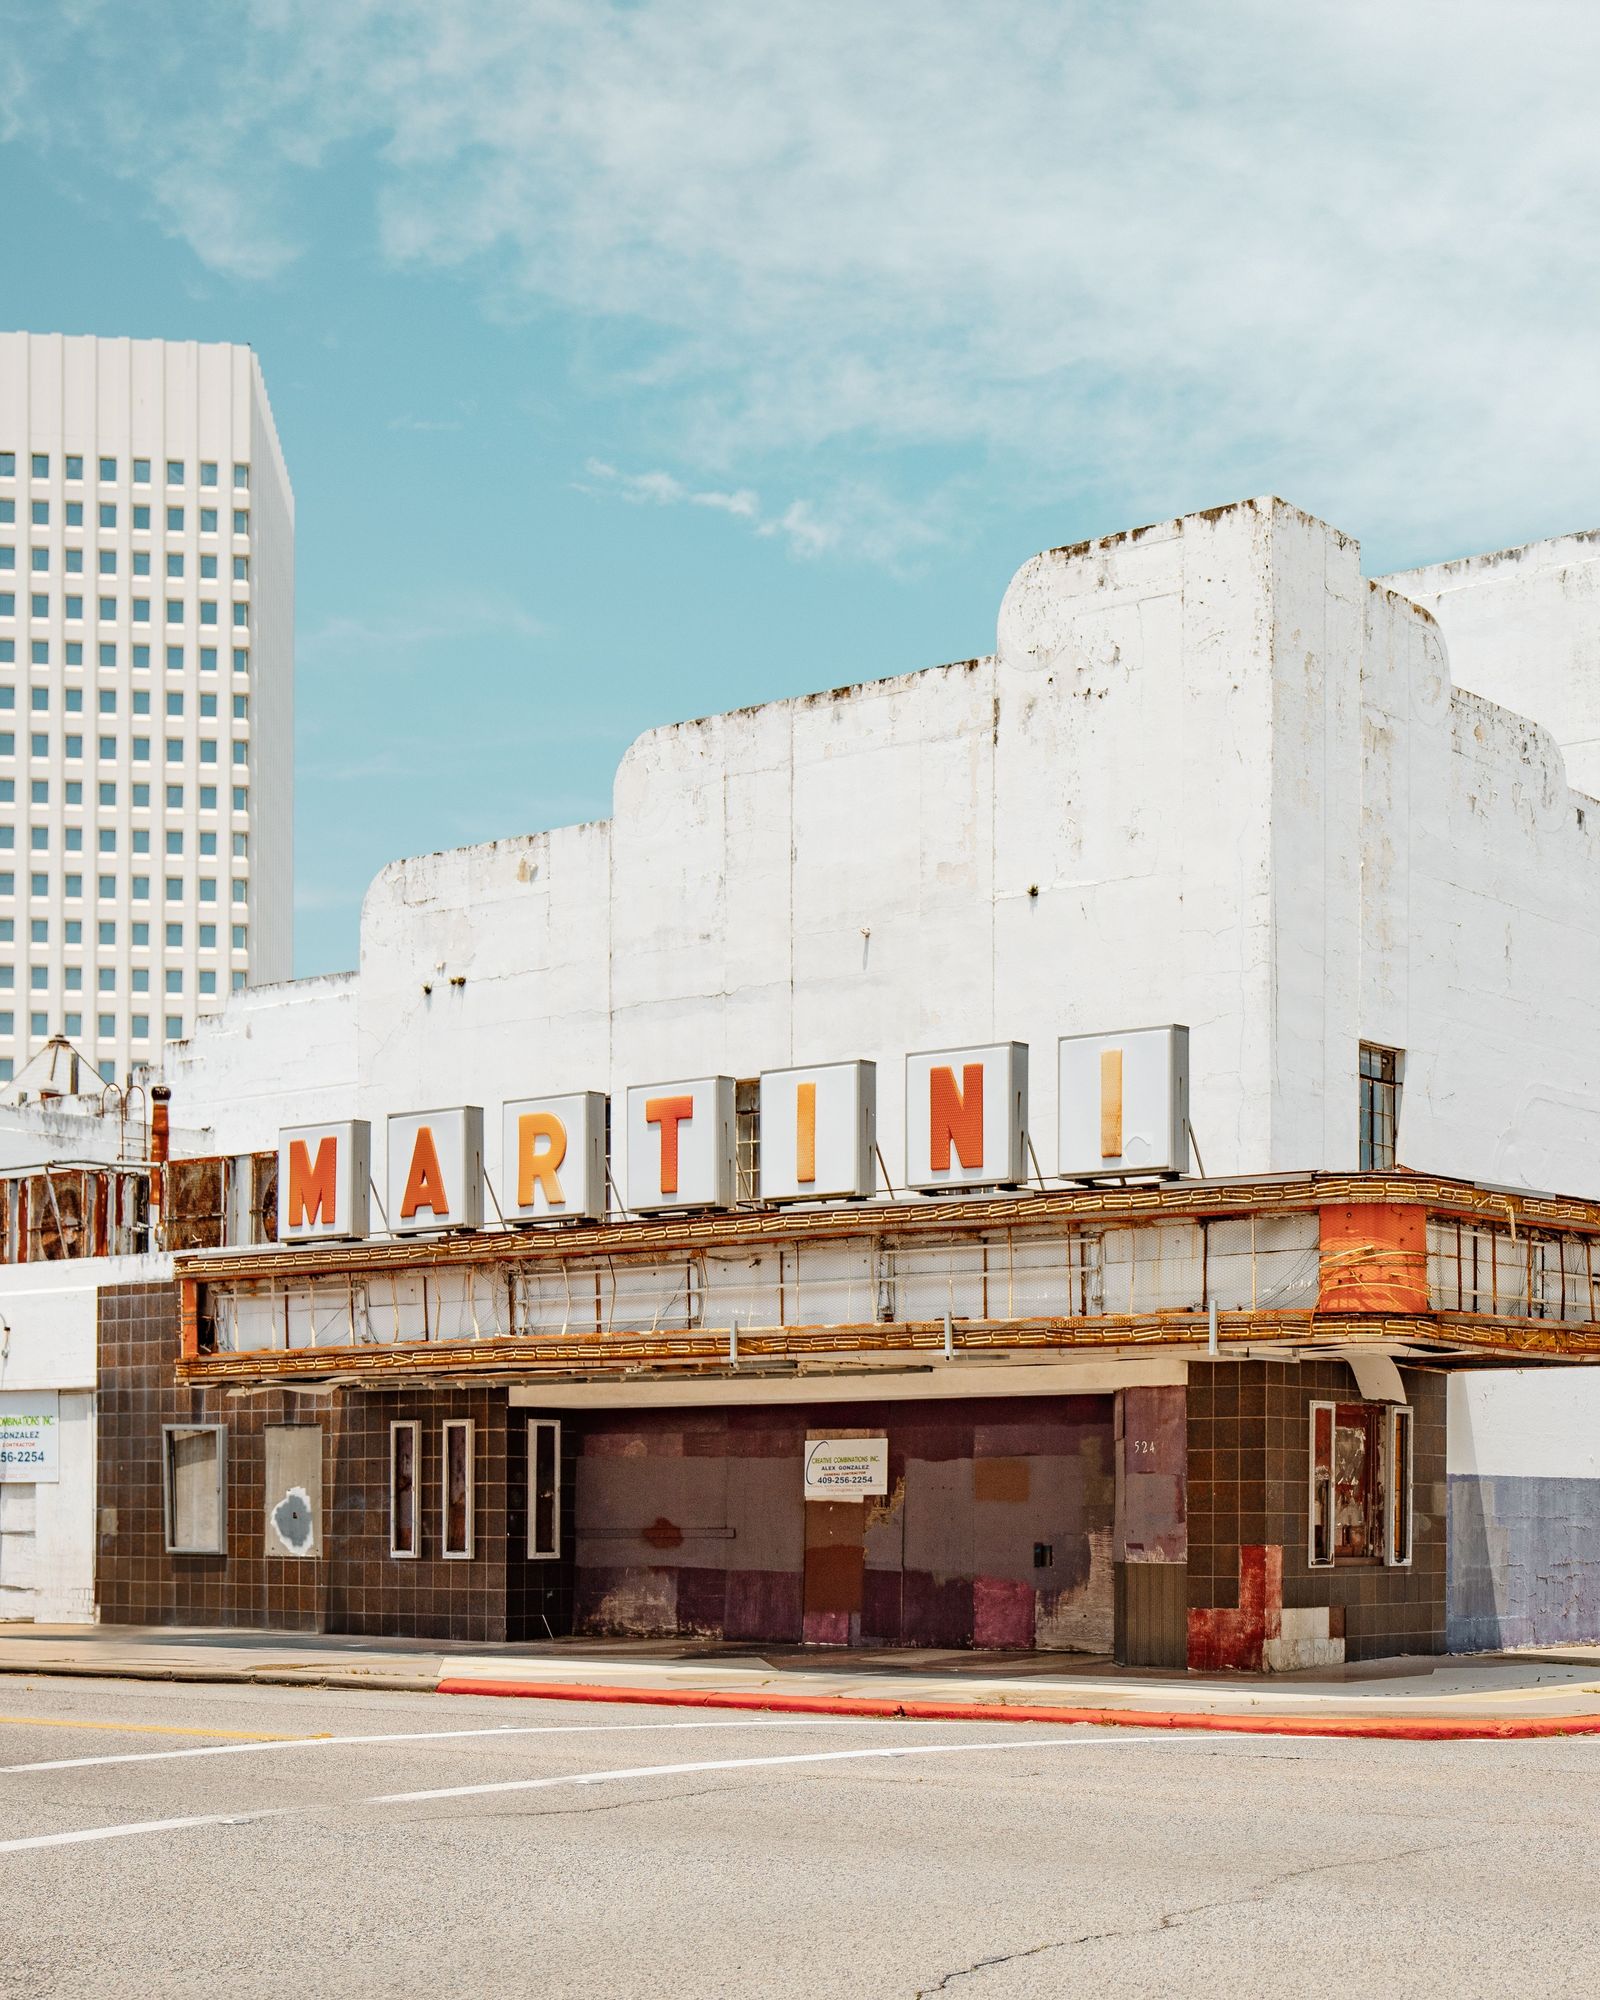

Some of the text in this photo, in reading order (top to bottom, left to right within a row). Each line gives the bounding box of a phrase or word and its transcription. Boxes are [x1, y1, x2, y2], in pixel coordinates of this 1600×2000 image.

[288, 1048, 1123, 1227] MARTINI
[1134, 1440, 1155, 1454] 524
[834, 1456, 868, 1464] COMBINATIONS
[817, 1476, 873, 1484] 409-256-2254
